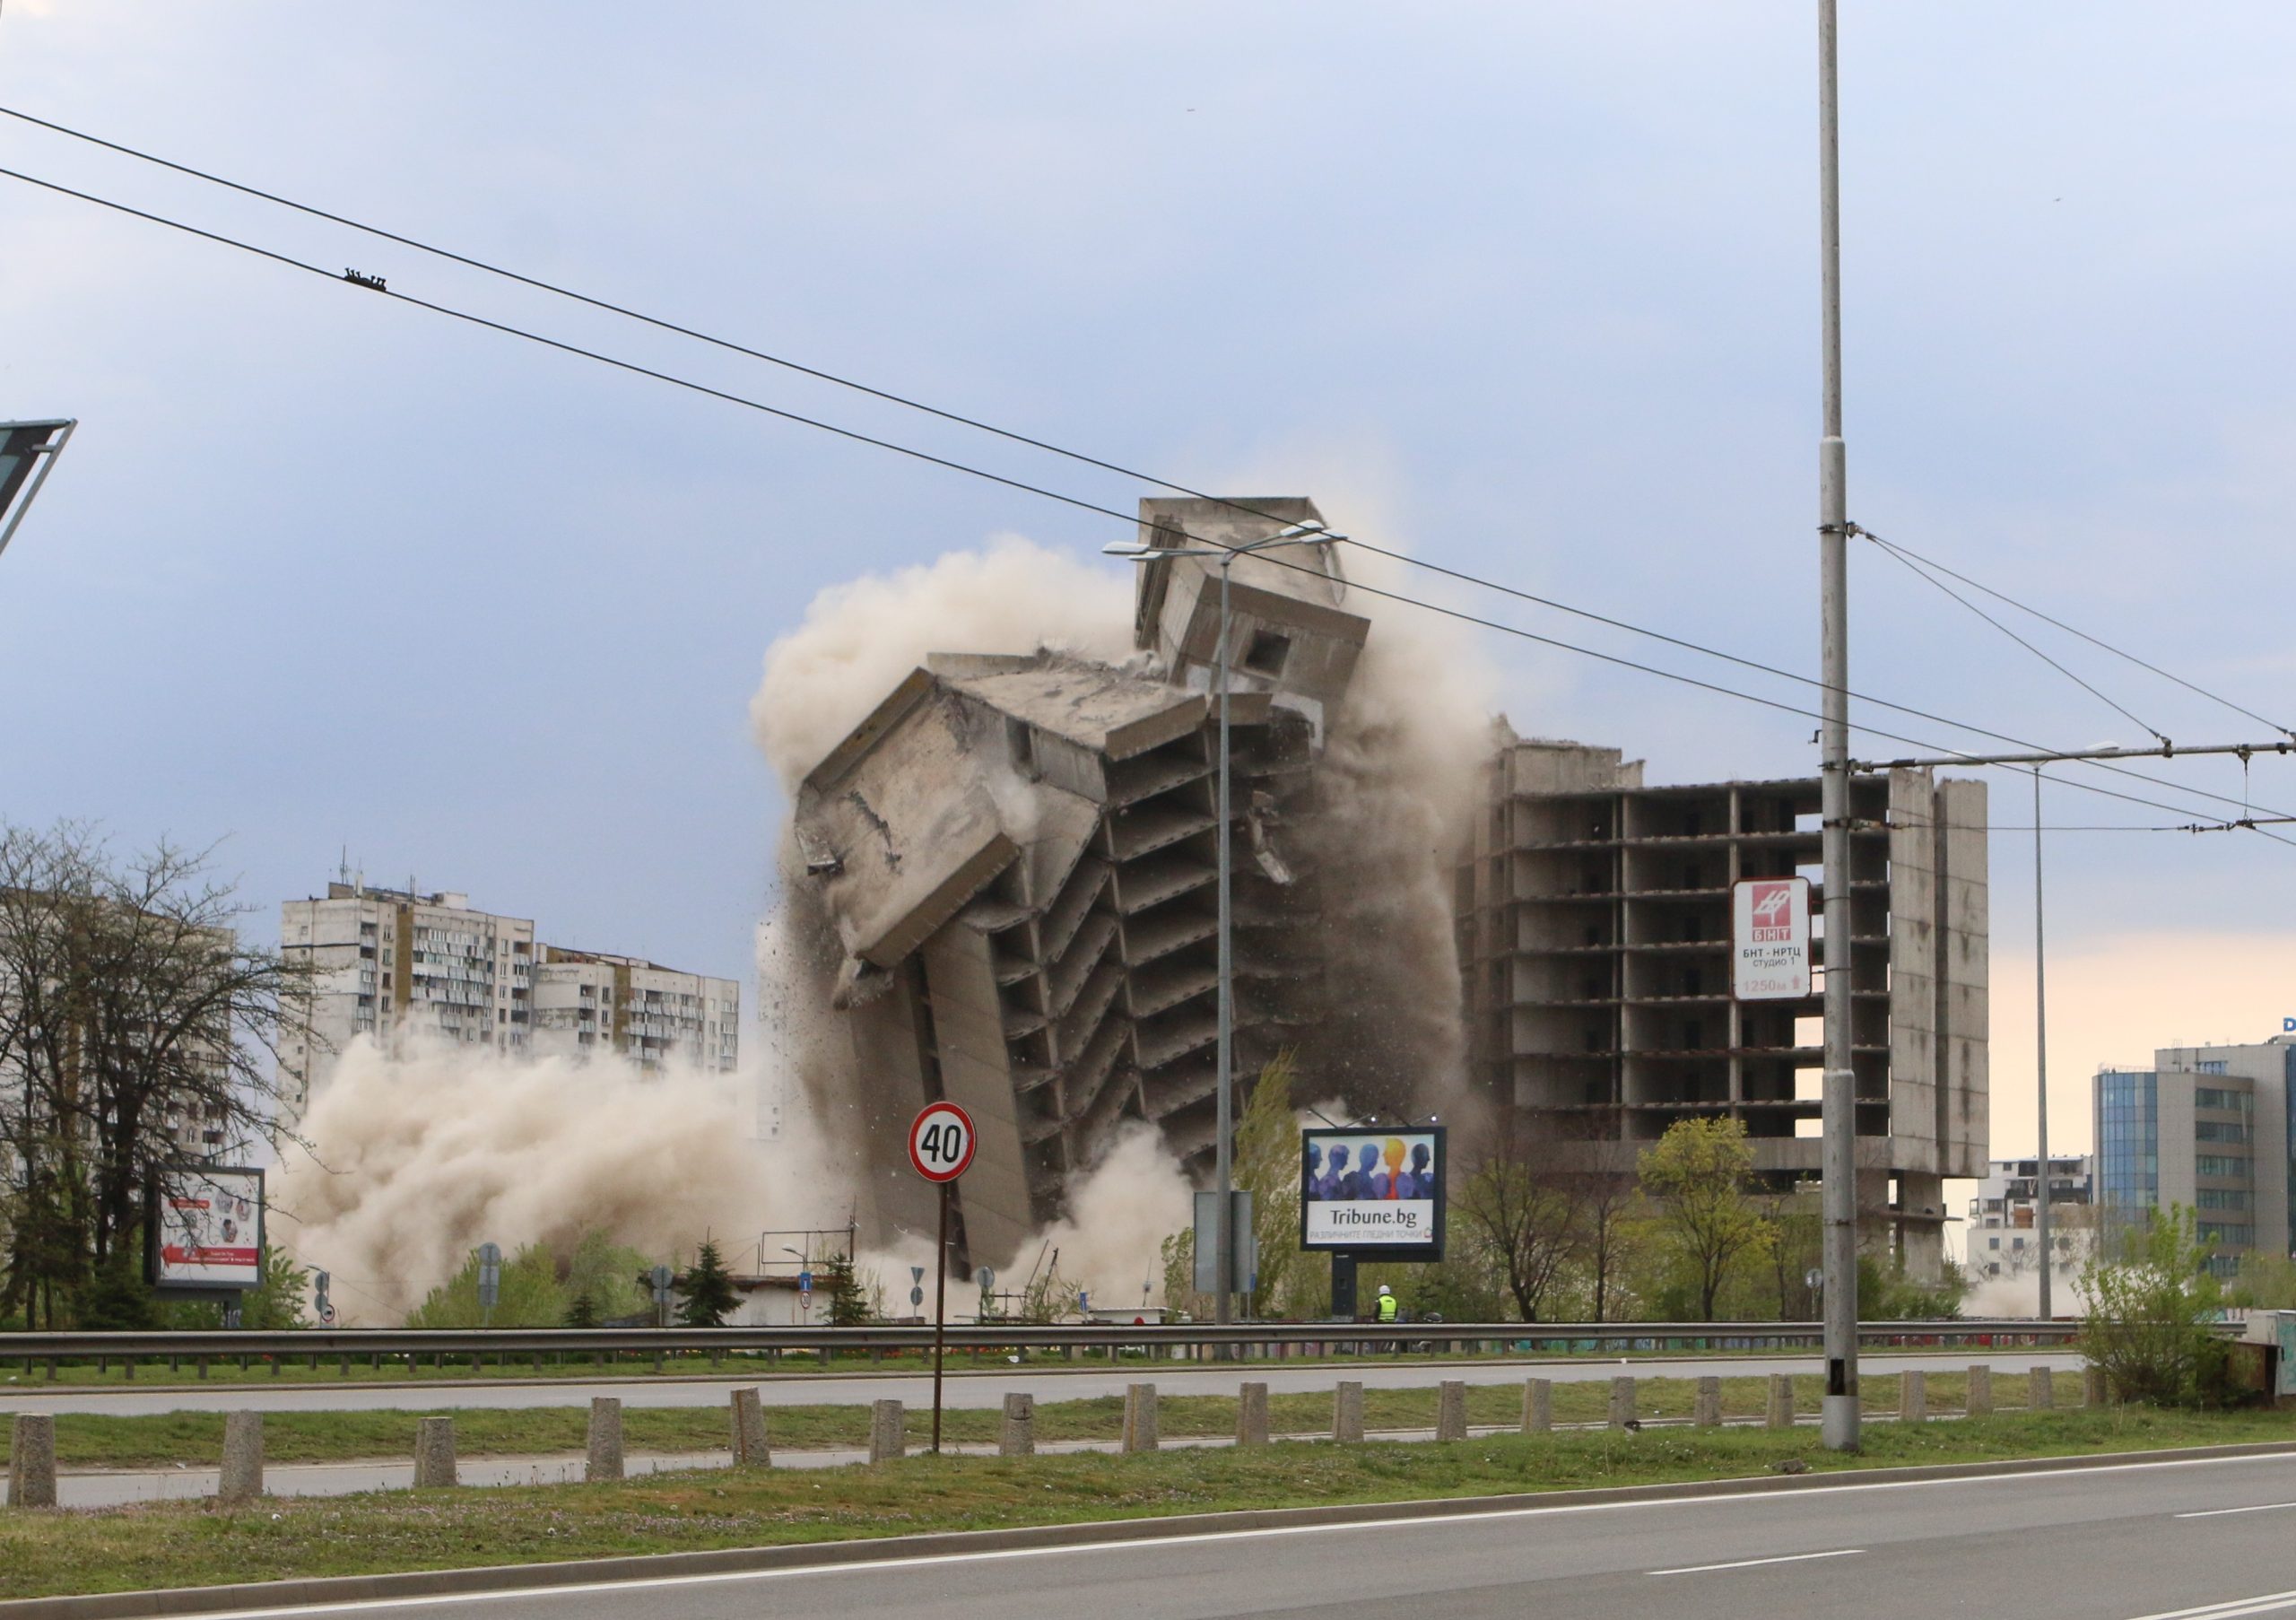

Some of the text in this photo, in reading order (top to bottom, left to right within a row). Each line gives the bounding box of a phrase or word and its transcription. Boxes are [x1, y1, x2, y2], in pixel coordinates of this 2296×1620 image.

[1754, 928, 1789, 942] БНТ
[1744, 948, 1763, 958] БНТ
[1773, 946, 1801, 958] НРТЦ
[1752, 956, 1795, 969] студио 1
[921, 1124, 961, 1163] 40
[1330, 1208, 1417, 1228] Tribune.bg
